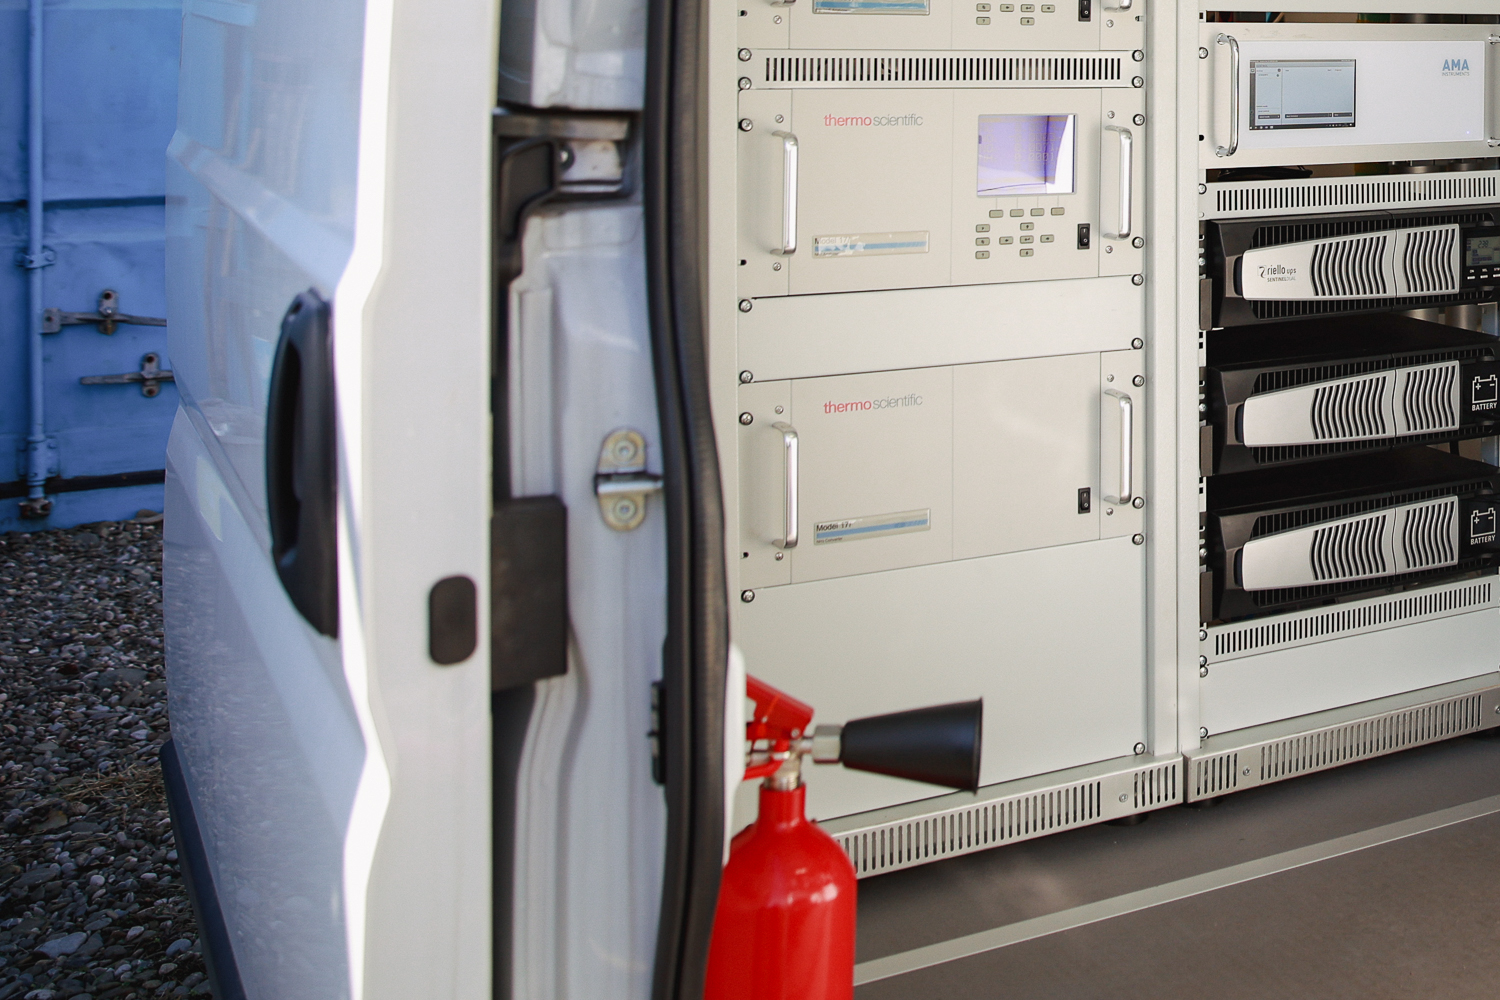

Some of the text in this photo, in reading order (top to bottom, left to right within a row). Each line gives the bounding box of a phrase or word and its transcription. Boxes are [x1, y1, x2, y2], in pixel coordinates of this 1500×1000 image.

[1442, 59, 1469, 71] AMA
[824, 113, 923, 126] thermo scientific
[1267, 264, 1286, 275] riello
[823, 393, 923, 414] thermo scientific
[1472, 402, 1497, 411] BATTERY
[816, 522, 838, 531] Model
[1471, 534, 1495, 545] BATTERY
